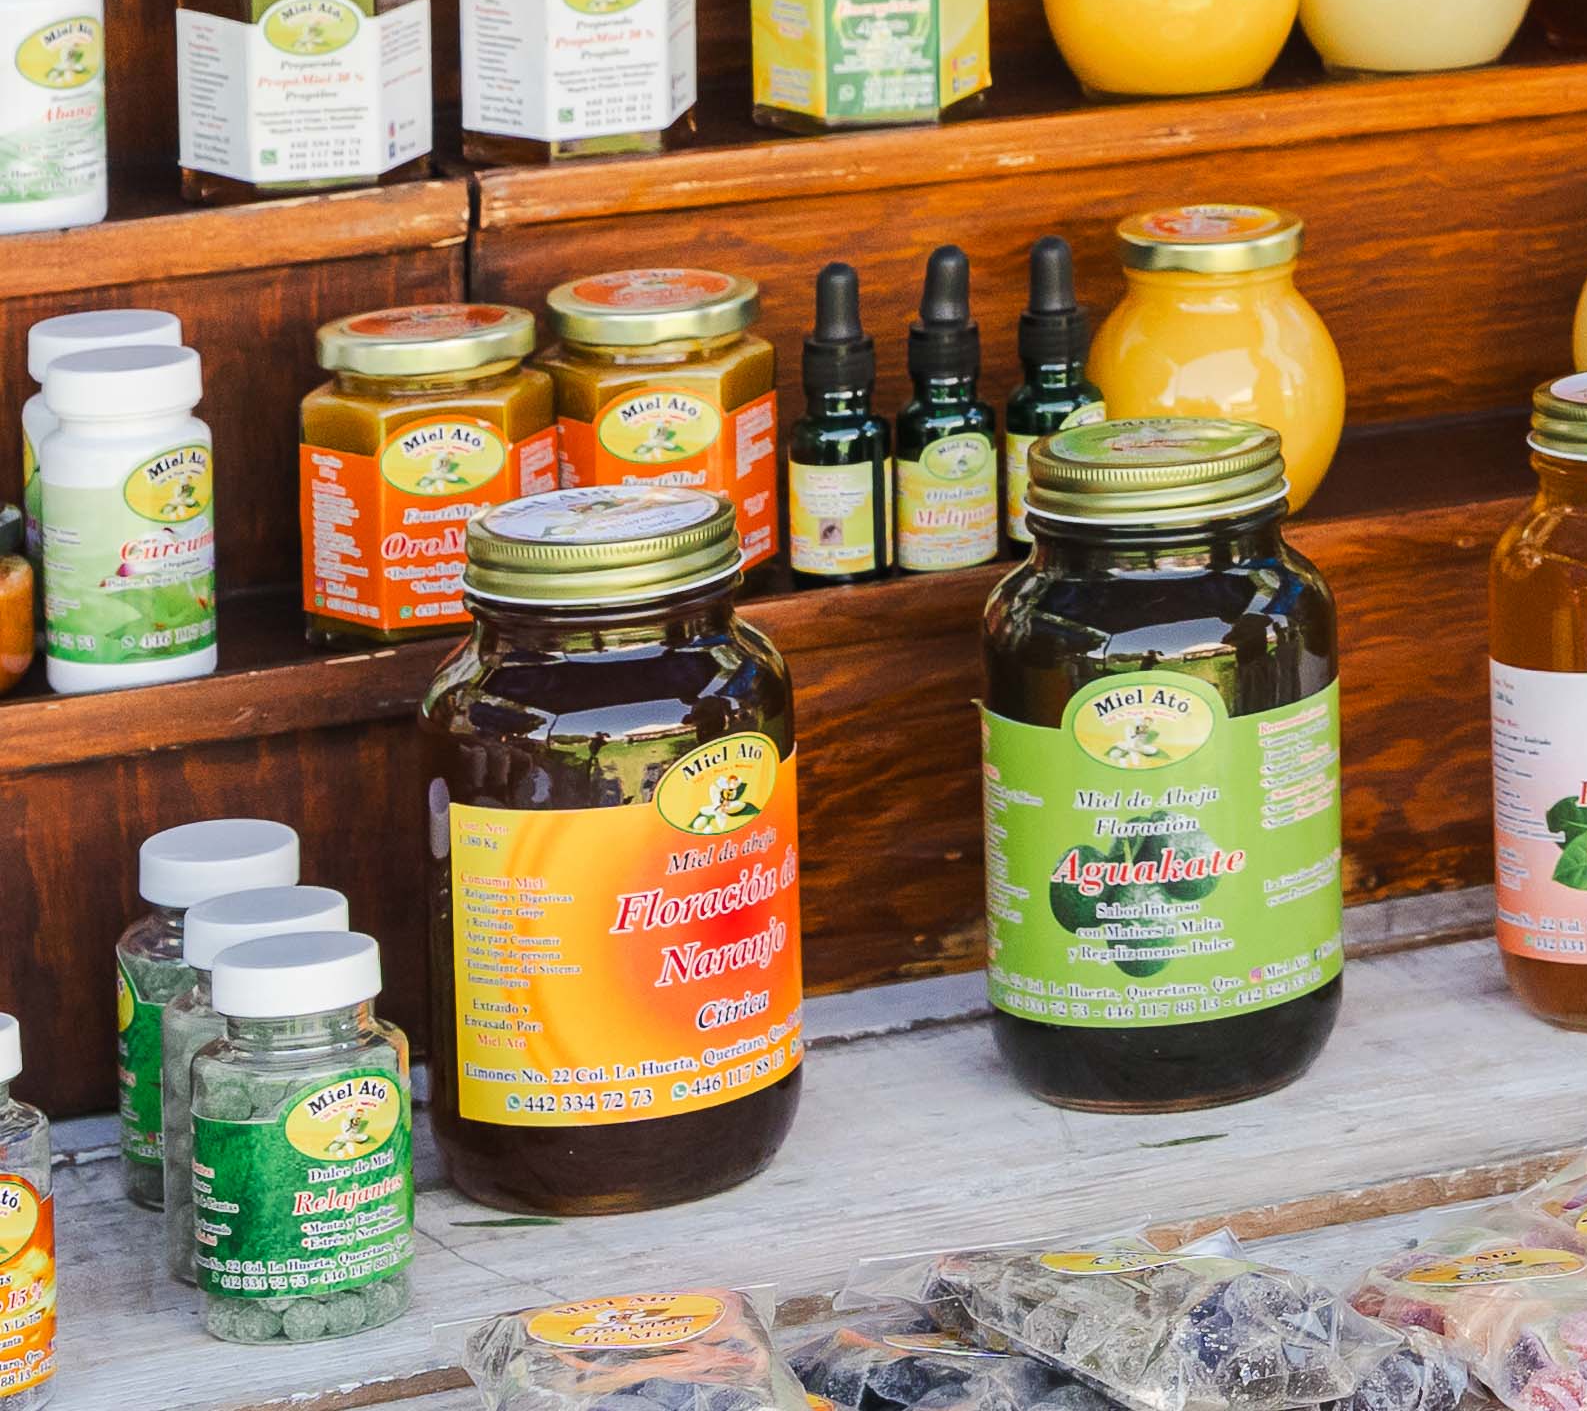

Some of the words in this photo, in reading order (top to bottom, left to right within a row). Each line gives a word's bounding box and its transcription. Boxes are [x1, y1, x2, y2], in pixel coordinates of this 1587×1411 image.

[620, 397, 661, 422] Miel
[403, 427, 444, 454] Miel
[147, 451, 184, 480] Miel
[1094, 689, 1144, 718] Miel
[1151, 689, 1190, 714] Ató
[681, 746, 728, 781] Miel
[735, 742, 764, 761] Ató
[1075, 791, 1121, 810] Miel
[1127, 792, 1152, 809] de
[1157, 787, 1219, 809] Abeja
[1095, 816, 1199, 837] Floración
[666, 845, 714, 876] Miel
[718, 840, 738, 862] de
[741, 826, 777, 856] abeja
[1051, 848, 1246, 896] Aguakate
[609, 863, 778, 934] Floración
[1095, 903, 1139, 919] Sabor
[1143, 902, 1201, 918] Intenso
[655, 917, 787, 986] Naranjo
[696, 988, 770, 1030] Cítrica
[464, 1062, 517, 1084] Limones
[521, 1068, 548, 1085] No.
[552, 1067, 570, 1084] 22
[575, 1066, 609, 1083] Col.
[615, 1064, 636, 1080] La
[641, 1057, 700, 1078] Huerta,
[702, 1036, 769, 1067] Querétaro,
[307, 1084, 353, 1117] Miel
[358, 1080, 387, 1100] Ató
[524, 1095, 556, 1113] 442
[561, 1093, 596, 1112] 334
[602, 1091, 625, 1110] 72
[631, 1088, 653, 1107] 73
[292, 1175, 403, 1216] Relajantes
[8, 1287, 28, 1312] 15
[554, 1300, 615, 1317] Miel
[629, 1326, 690, 1340] Miel
